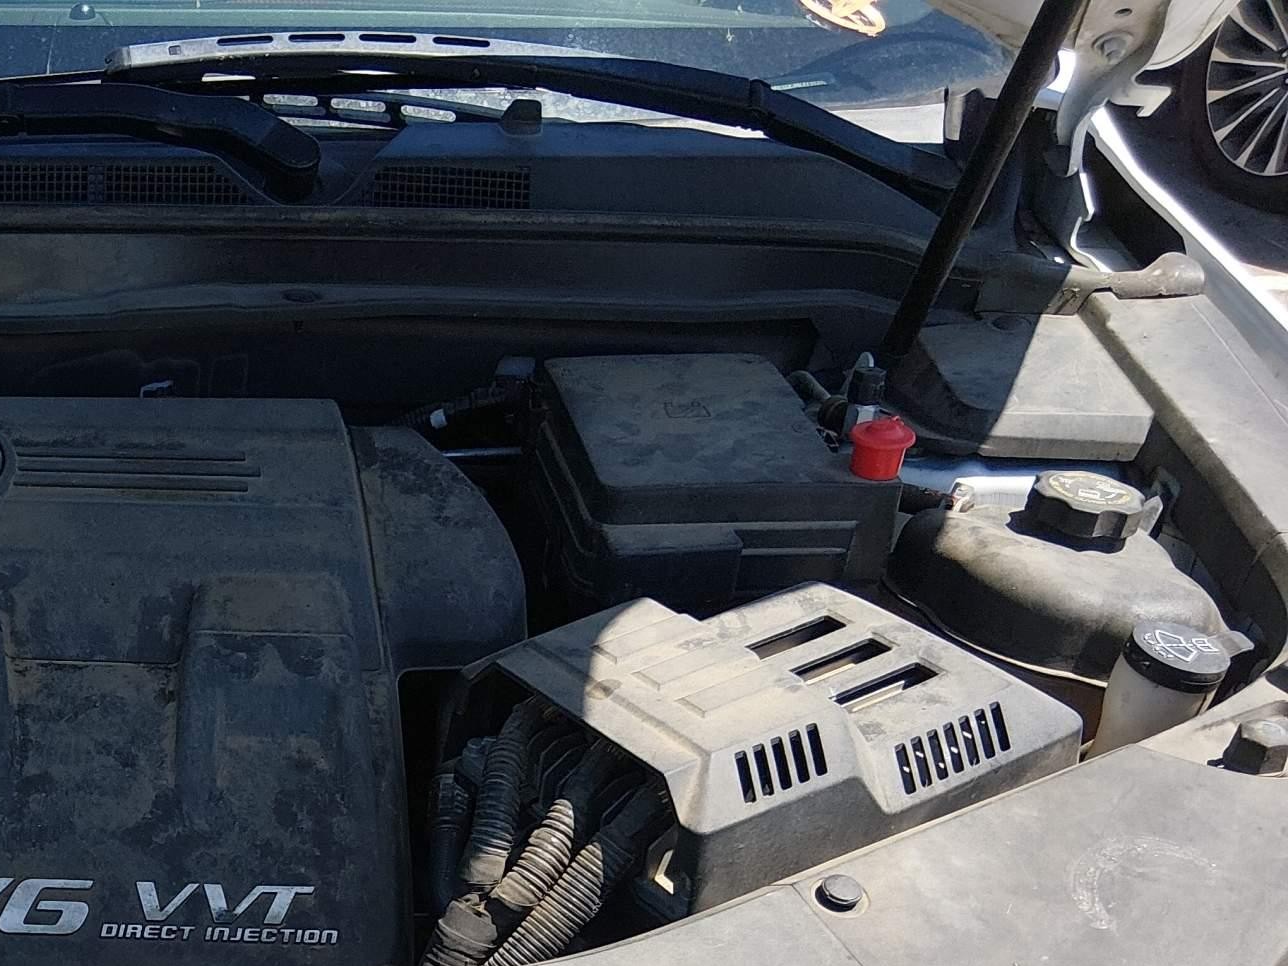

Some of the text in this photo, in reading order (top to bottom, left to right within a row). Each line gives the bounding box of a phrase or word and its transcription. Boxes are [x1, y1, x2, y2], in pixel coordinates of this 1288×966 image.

[136, 881, 315, 923] VVT
[100, 923, 338, 943] DIRECT INJECTION
